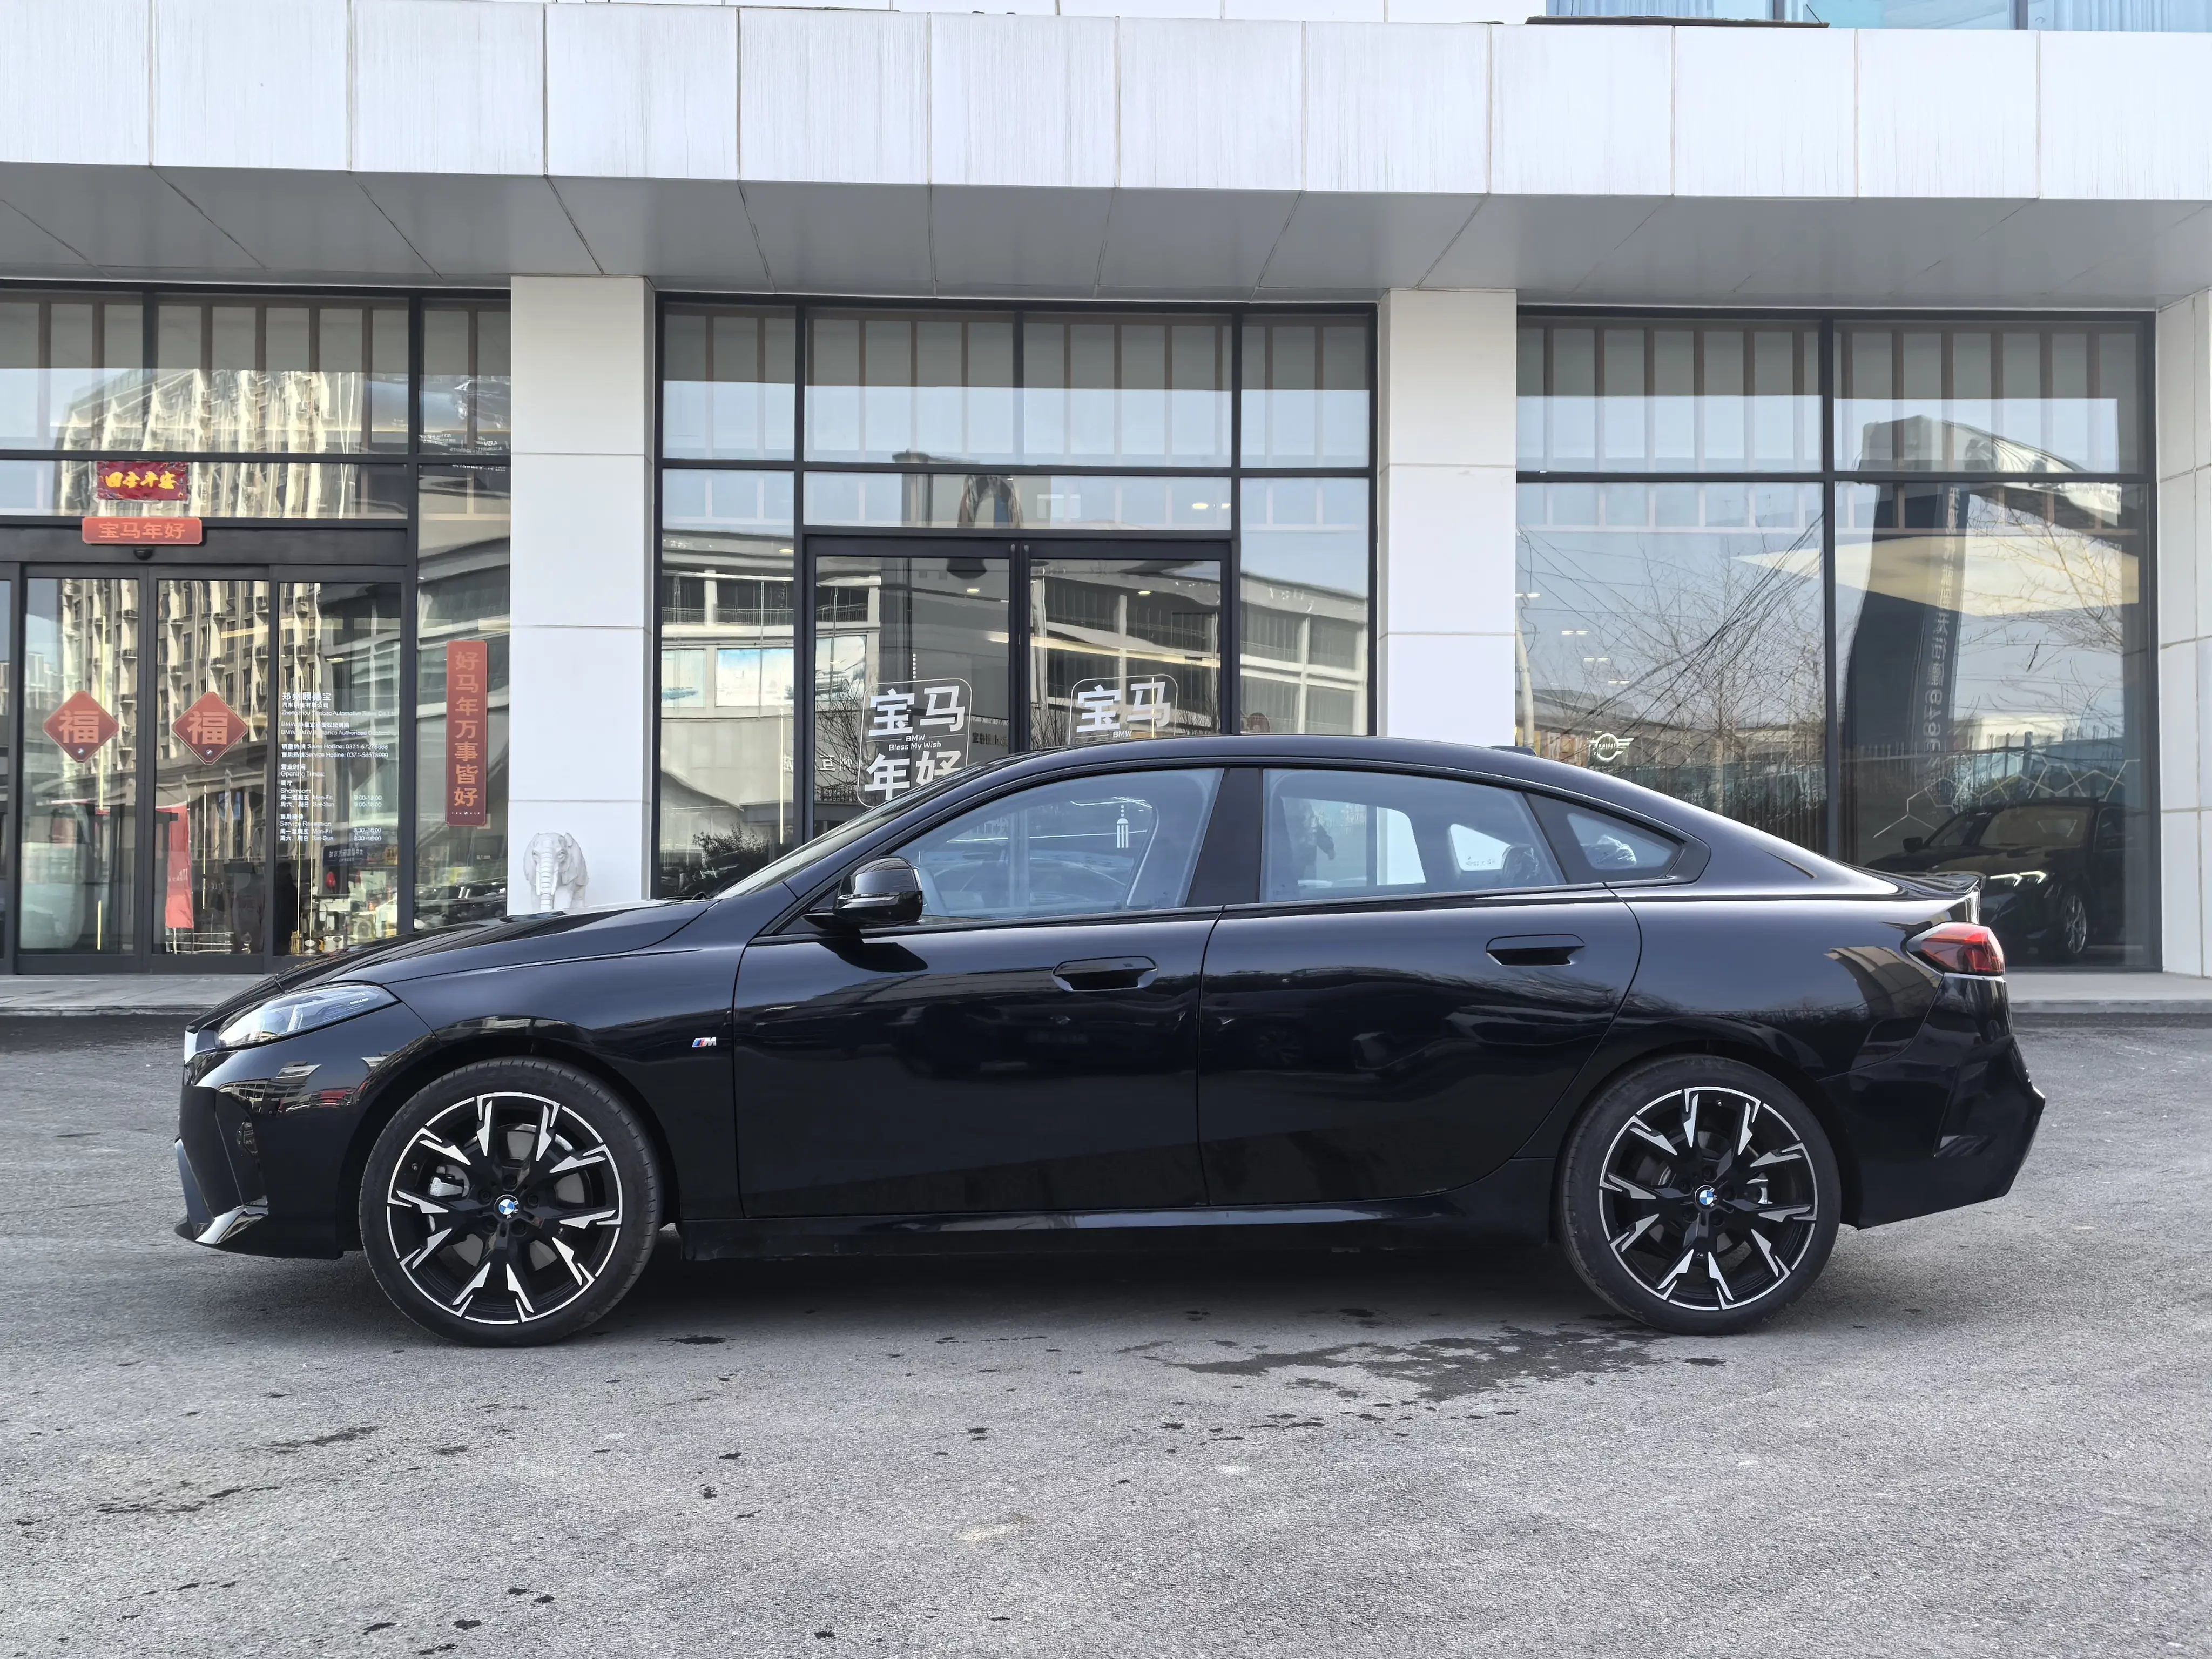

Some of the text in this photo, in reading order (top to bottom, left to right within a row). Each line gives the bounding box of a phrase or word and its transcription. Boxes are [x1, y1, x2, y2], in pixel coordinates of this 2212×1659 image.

[98, 522, 186, 539] 宝马年好
[868, 686, 965, 737] 宝马
[1076, 682, 1171, 733] 宝马
[58, 709, 99, 744] 福
[187, 711, 228, 745] 福
[454, 651, 480, 807] 好马年万事皆好
[1112, 730, 1132, 738] BMW
[911, 743, 922, 751] My
[864, 751, 962, 801] 年好
